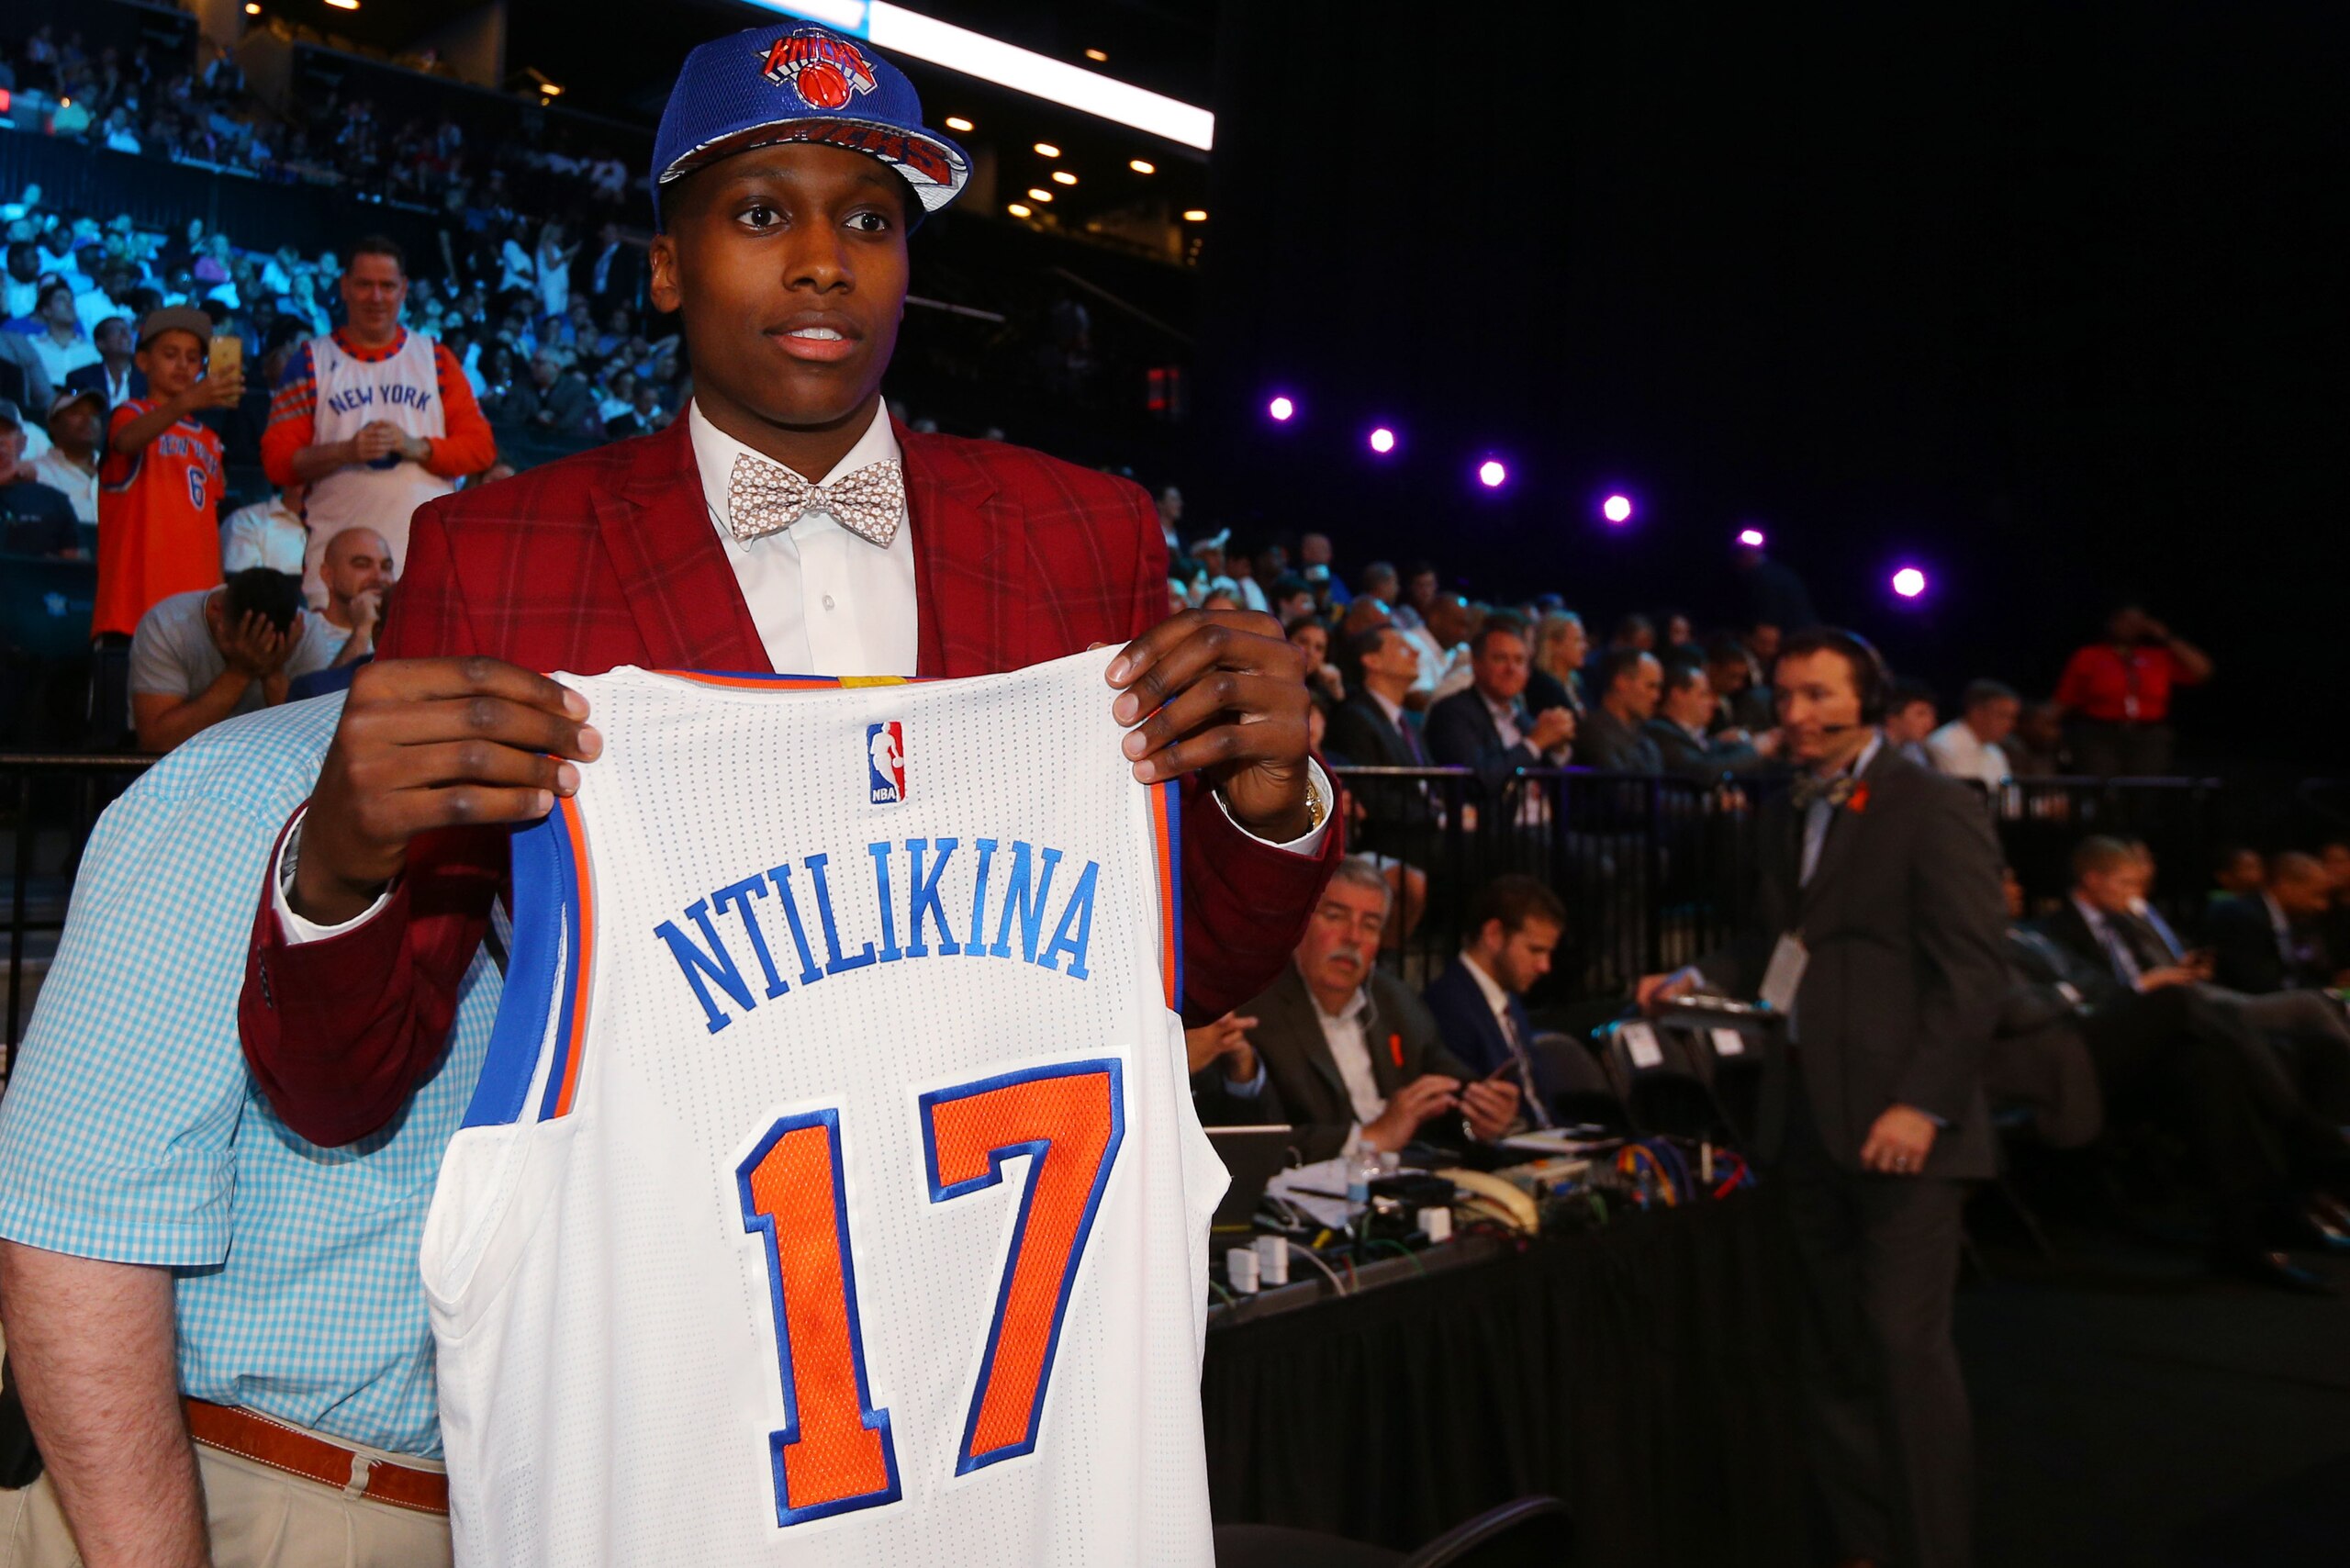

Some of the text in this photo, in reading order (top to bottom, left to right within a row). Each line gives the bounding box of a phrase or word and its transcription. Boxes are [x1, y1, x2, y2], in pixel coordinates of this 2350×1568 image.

[764, 37, 875, 88] KNICKS
[329, 384, 431, 417] NEW YORK
[187, 465, 207, 512] 6
[872, 787, 896, 802] NBA
[654, 837, 1100, 1035] NTILIKINA
[735, 1058, 1125, 1528] 17
